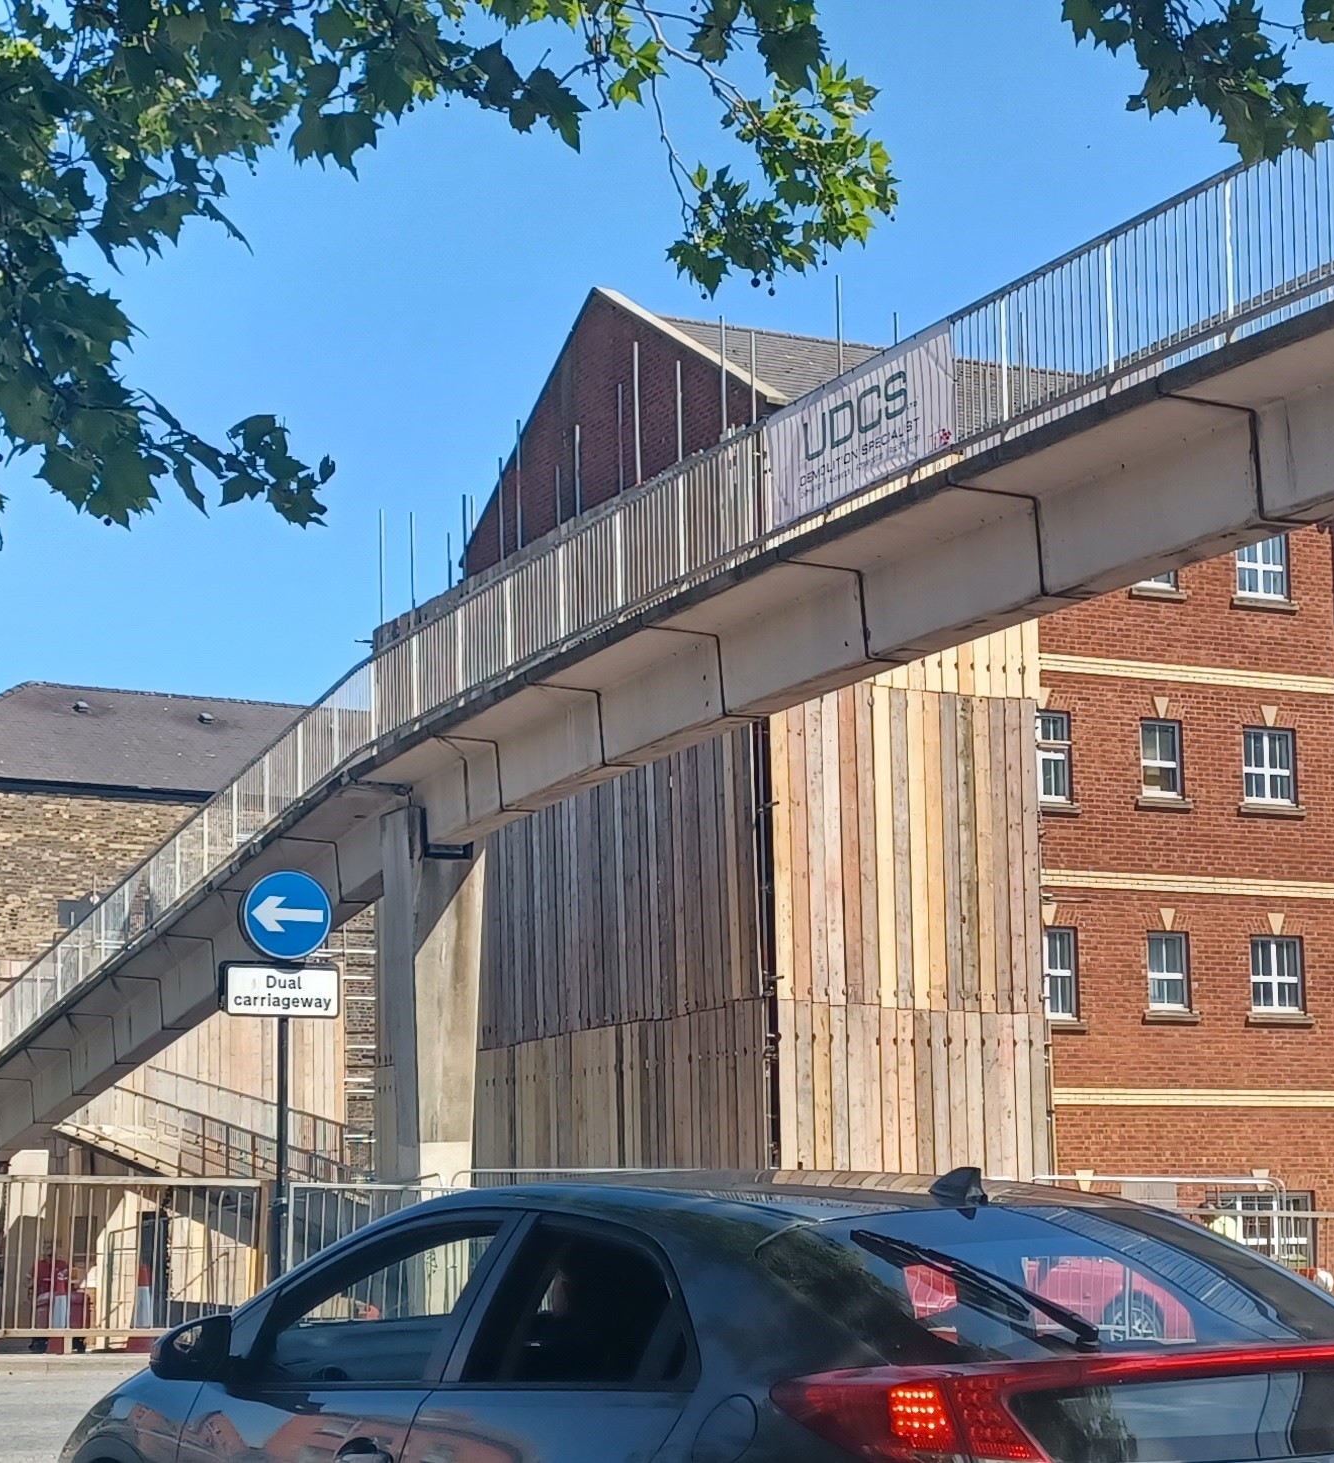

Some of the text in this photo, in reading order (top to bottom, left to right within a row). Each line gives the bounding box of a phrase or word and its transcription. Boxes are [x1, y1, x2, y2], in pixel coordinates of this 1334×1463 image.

[802, 370, 908, 461] UDCS
[800, 448, 858, 487] DEMOLITION
[862, 417, 919, 455] SPECIALIST
[233, 993, 332, 1011] carriageway
[266, 975, 302, 990] Dual
